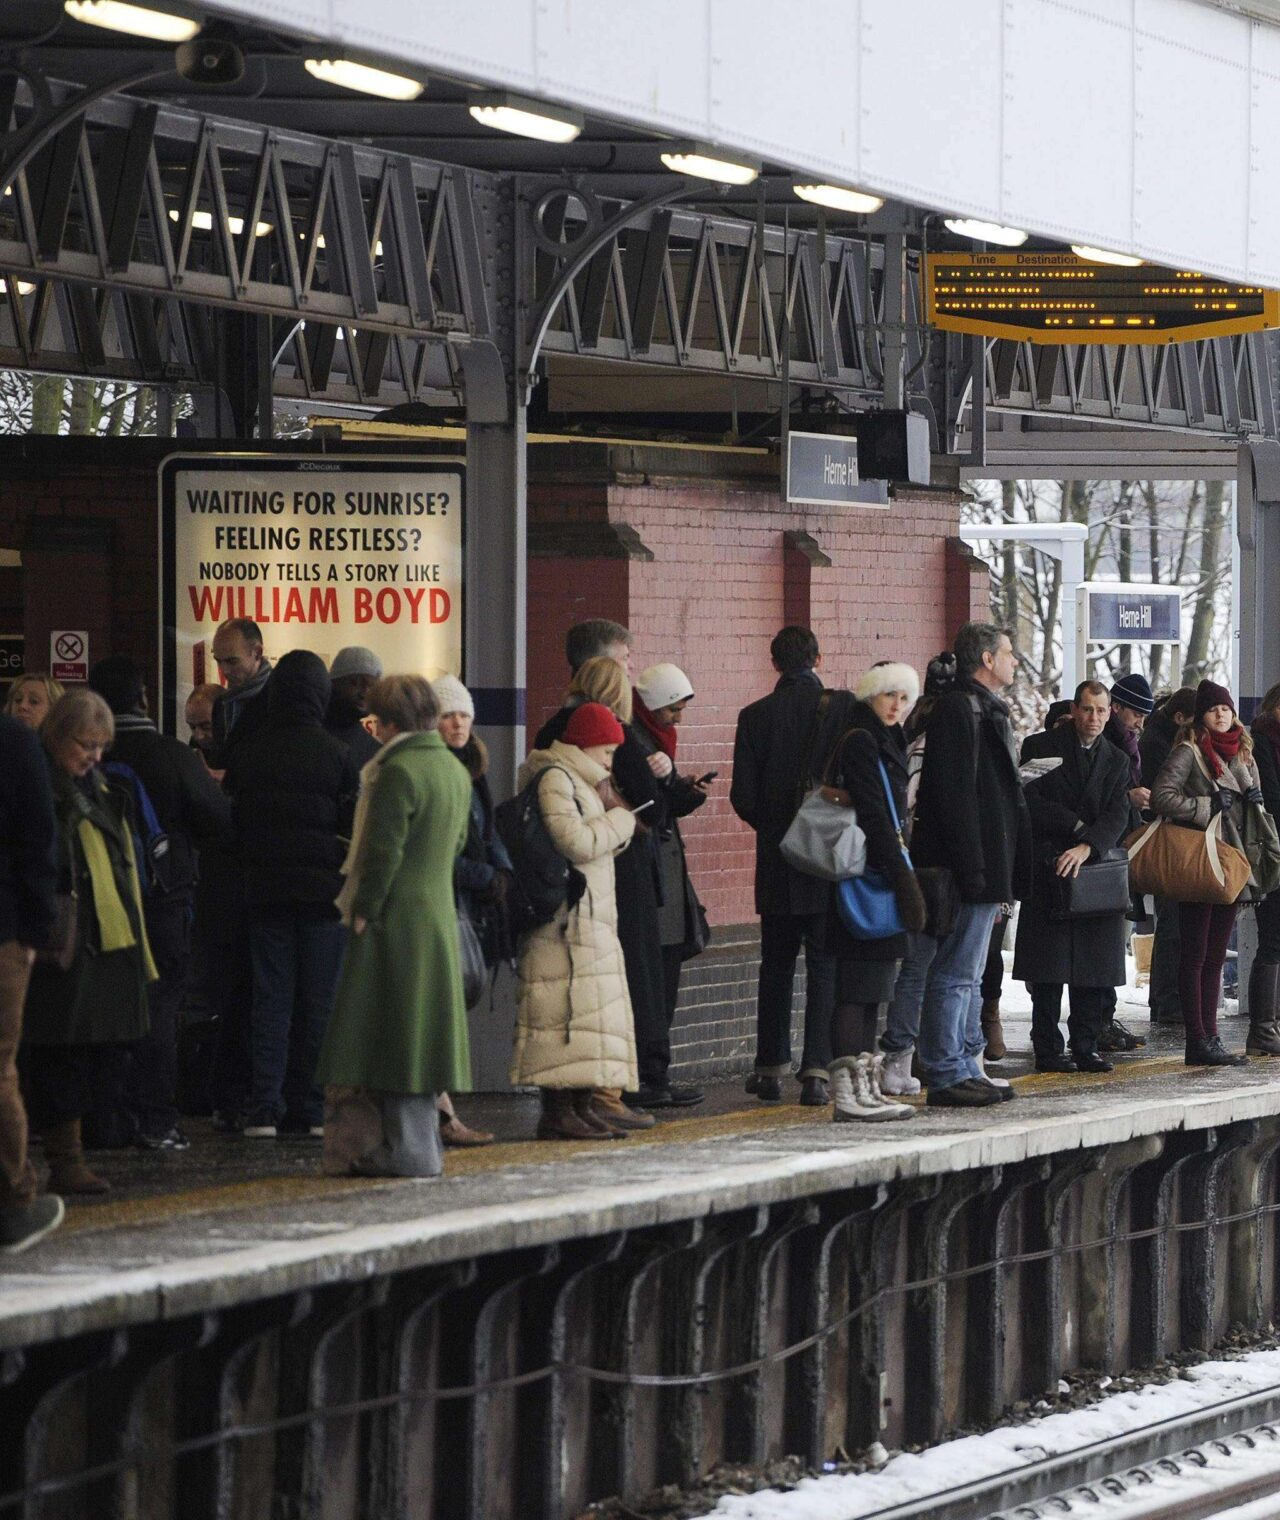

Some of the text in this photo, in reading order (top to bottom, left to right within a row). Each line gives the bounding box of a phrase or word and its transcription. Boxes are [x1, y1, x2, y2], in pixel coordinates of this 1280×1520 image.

[969, 254, 1078, 265] Time Destination
[298, 462, 341, 470] JCDecaux
[824, 455, 846, 485] Herne
[186, 490, 450, 516] WAITING FOR SUNRISE?
[215, 526, 422, 551] FEELING RESTLESS?
[199, 562, 440, 582] NOBODY TELLS A STORY LIKE
[188, 585, 451, 624] WILLIAM BOYD
[1119, 605, 1140, 628] Herne
